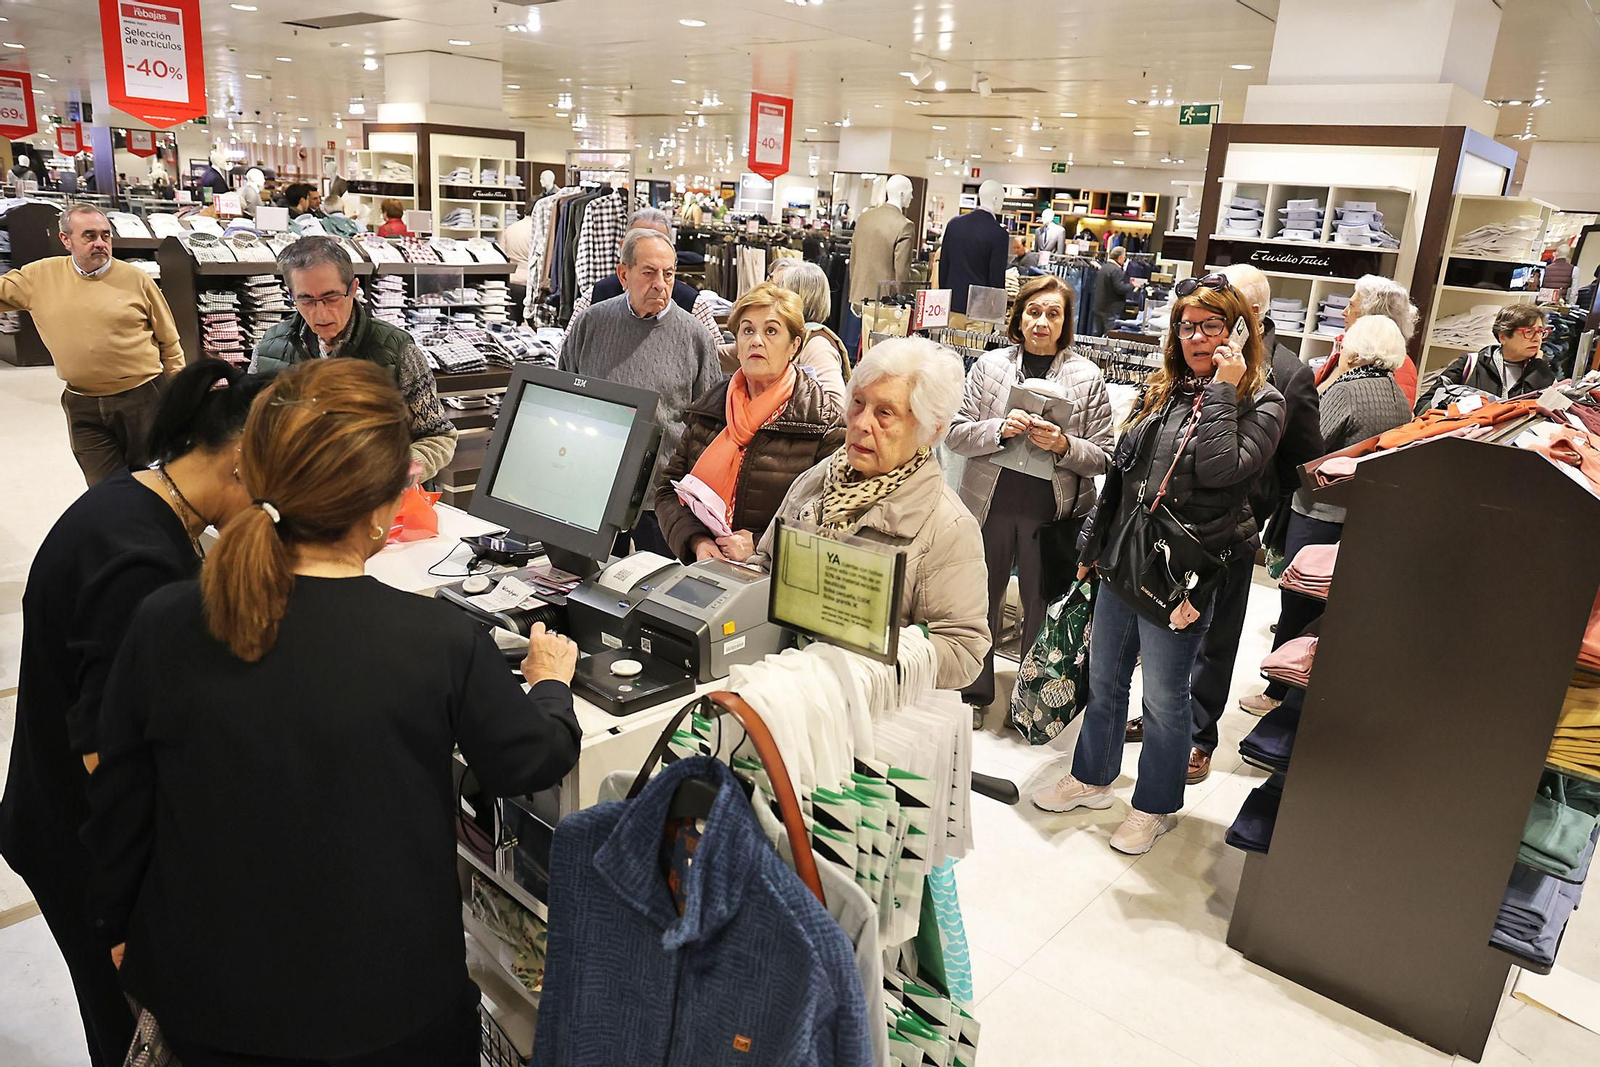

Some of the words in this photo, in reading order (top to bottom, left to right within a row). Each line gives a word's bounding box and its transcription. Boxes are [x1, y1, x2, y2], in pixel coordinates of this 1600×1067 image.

[124, 27, 171, 41] Selección
[125, 36, 138, 45] de
[140, 39, 182, 51] artículos
[127, 58, 183, 80] -40%
[758, 137, 781, 150] -40%
[1250, 250, 1298, 264] Emidio
[1298, 255, 1330, 267] Tucci
[925, 304, 947, 317] -20%
[573, 378, 588, 388] IBM
[827, 552, 840, 565] YA
